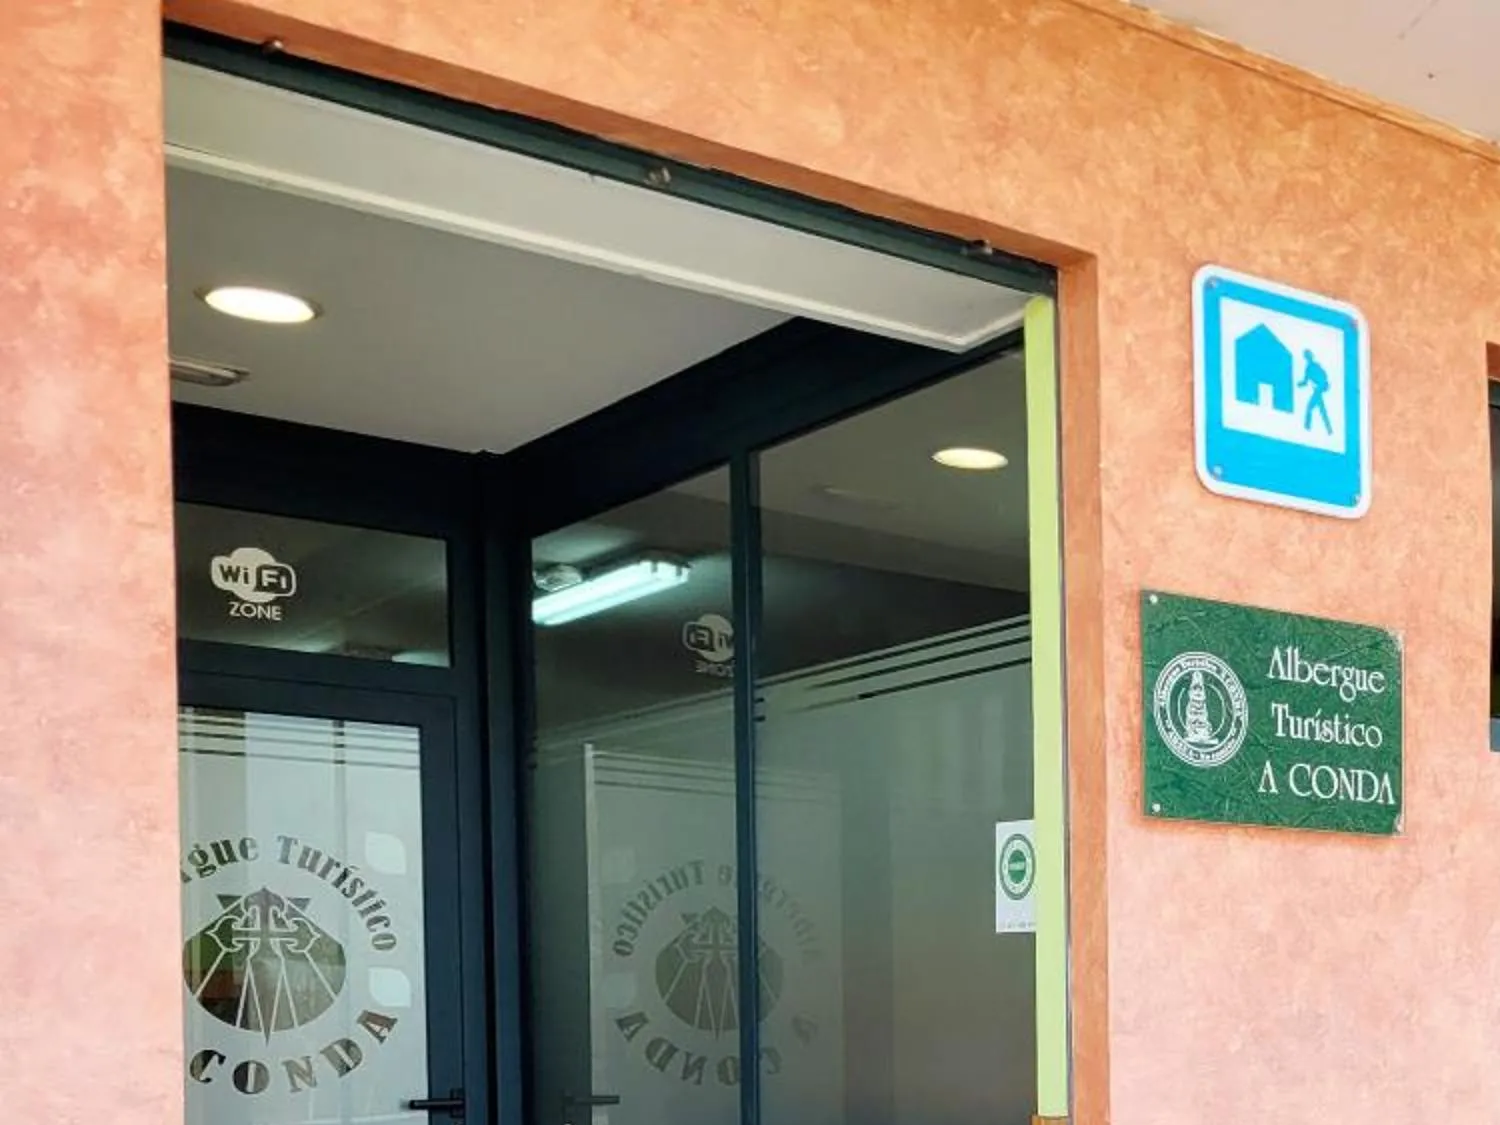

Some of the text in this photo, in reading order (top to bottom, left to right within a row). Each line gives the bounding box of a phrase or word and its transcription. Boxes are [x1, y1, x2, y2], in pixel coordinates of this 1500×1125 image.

[228, 601, 282, 620] ZONE
[1267, 646, 1385, 702] Albergue
[1271, 703, 1383, 749] Turístico
[1257, 760, 1396, 805] A CONDA
[277, 834, 398, 952] Turístico
[188, 1009, 399, 1096] CONDA
